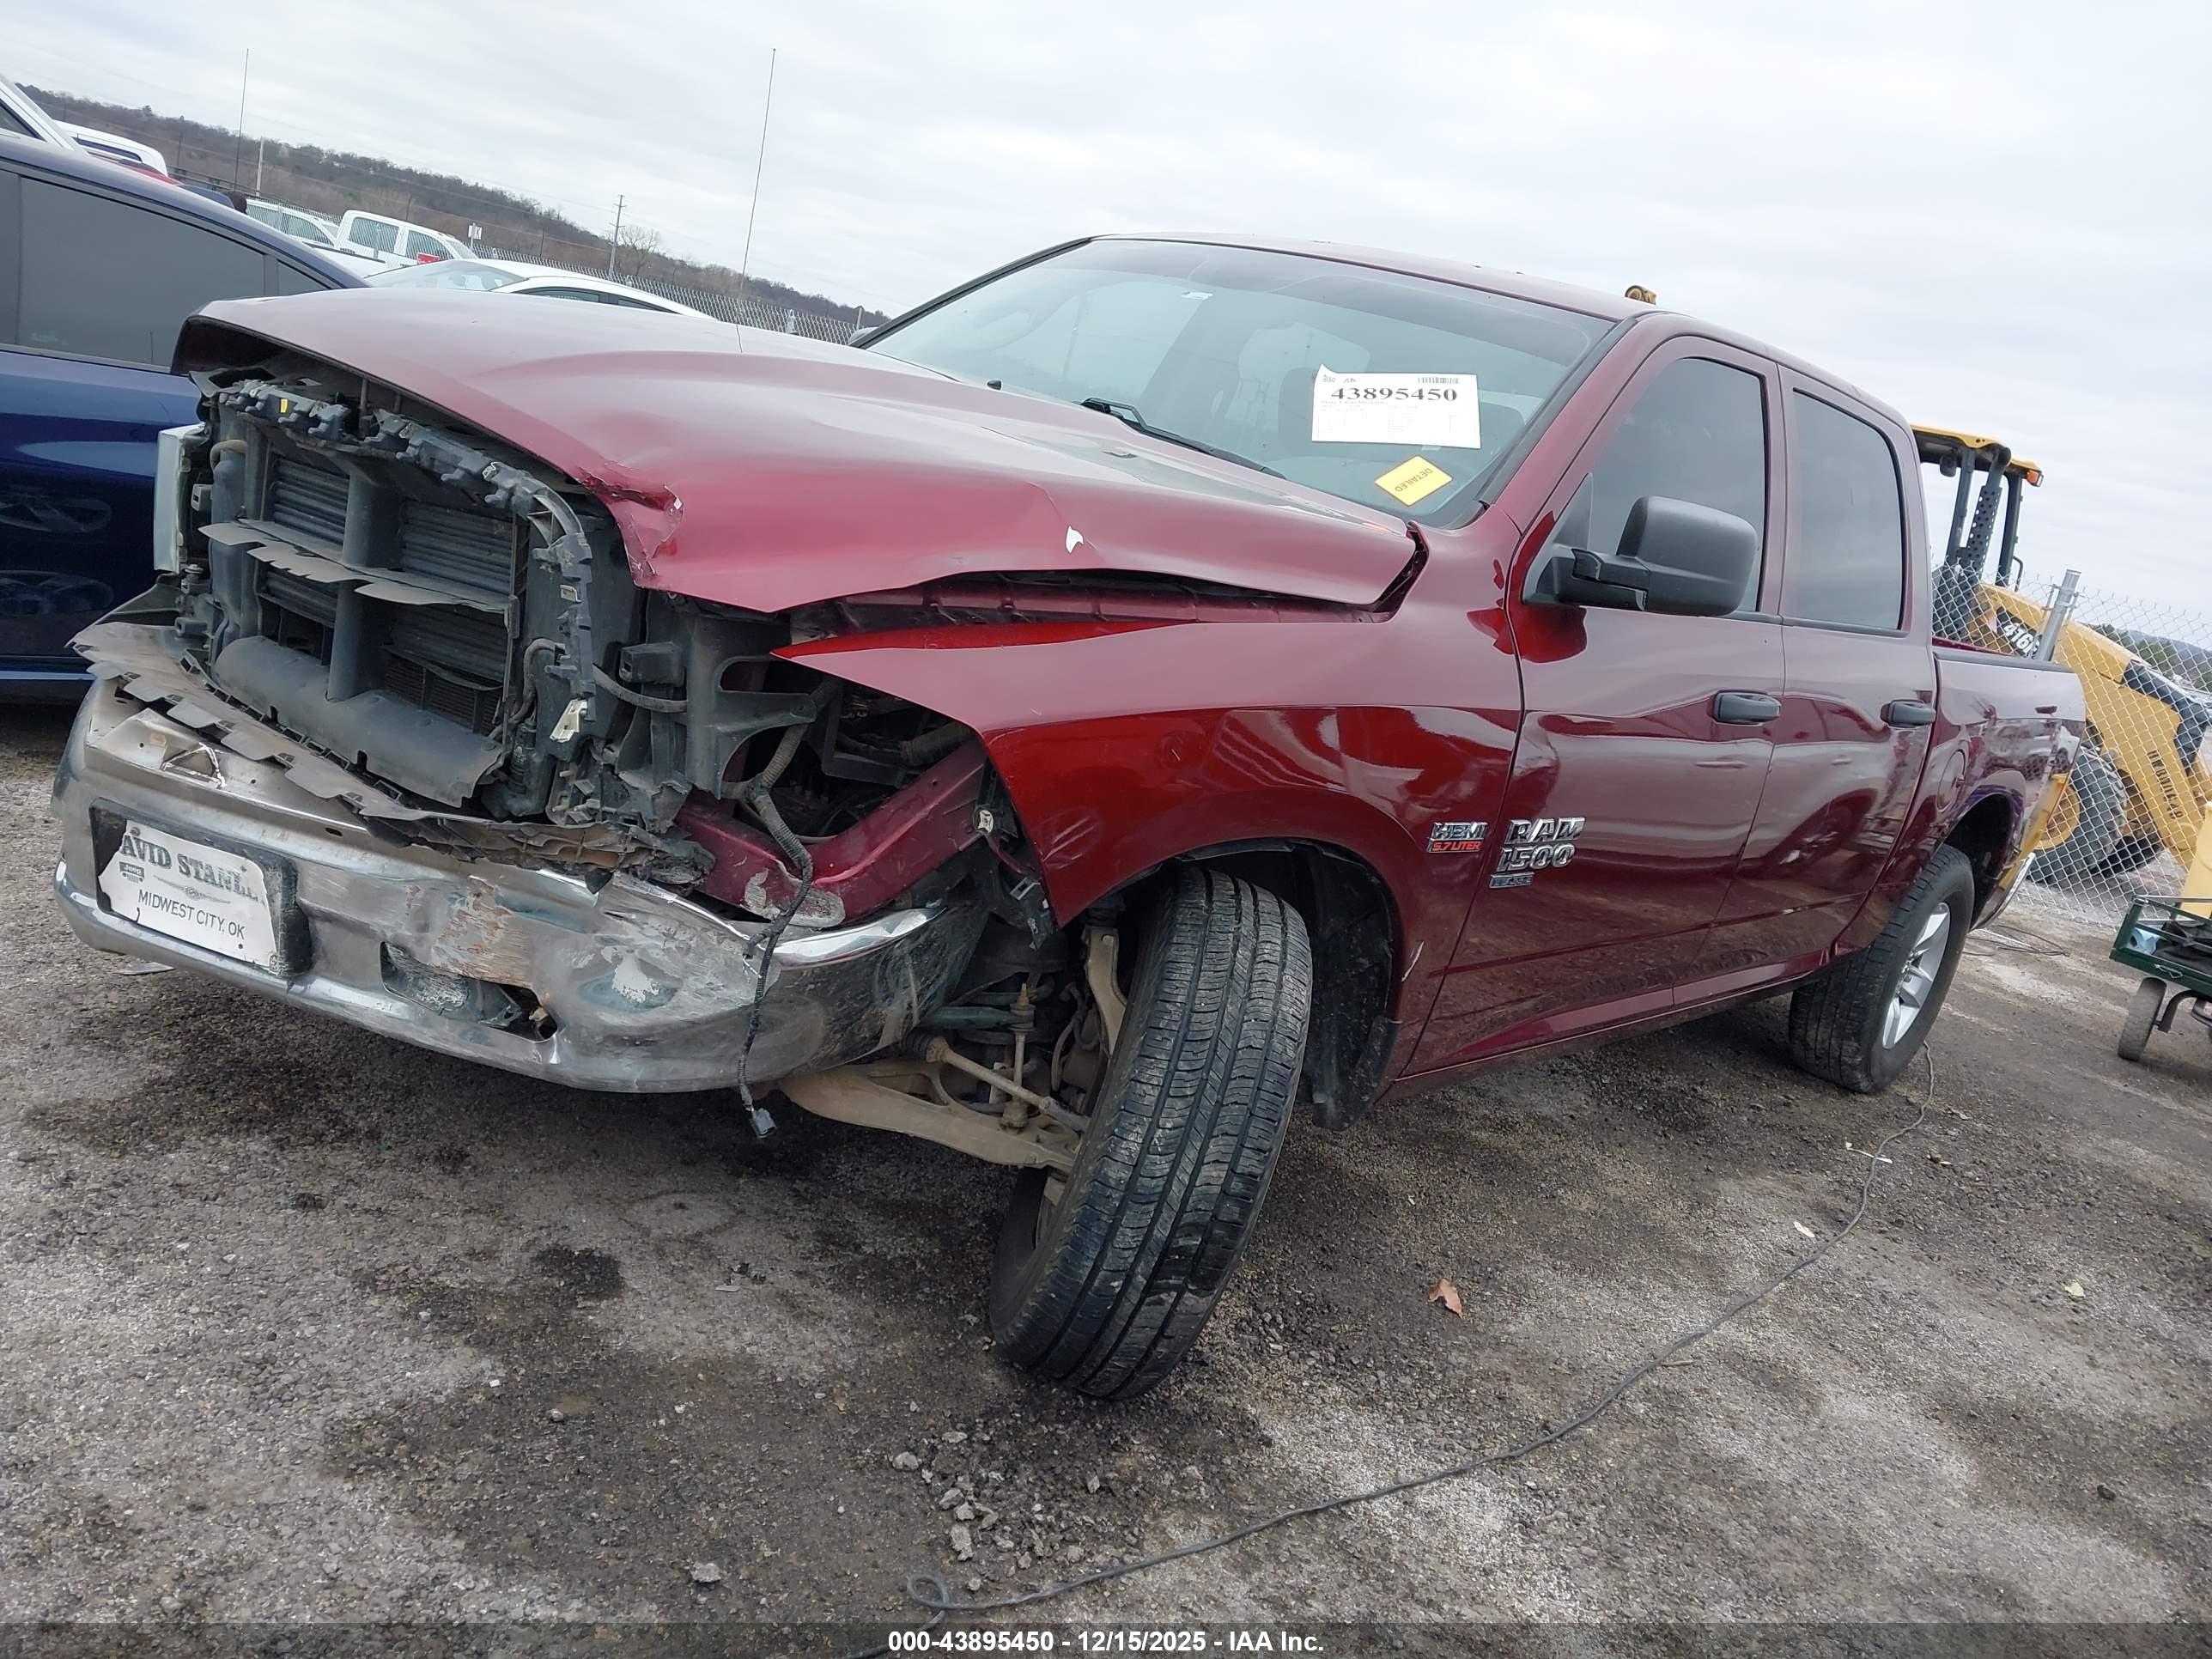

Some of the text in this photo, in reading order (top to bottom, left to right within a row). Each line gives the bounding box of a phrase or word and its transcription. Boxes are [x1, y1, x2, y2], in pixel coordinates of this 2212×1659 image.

[1331, 387, 1458, 402] 43895450
[1394, 467, 1434, 493] DETAILED
[1504, 816, 1587, 845] RAM
[1431, 841, 1482, 852] 5.7 LITER
[1497, 843, 1577, 872] 1500
[124, 865, 142, 875] Jeep
[138, 890, 195, 921] MIDWEST
[197, 910, 226, 933] CITY,
[228, 921, 246, 940] OK
